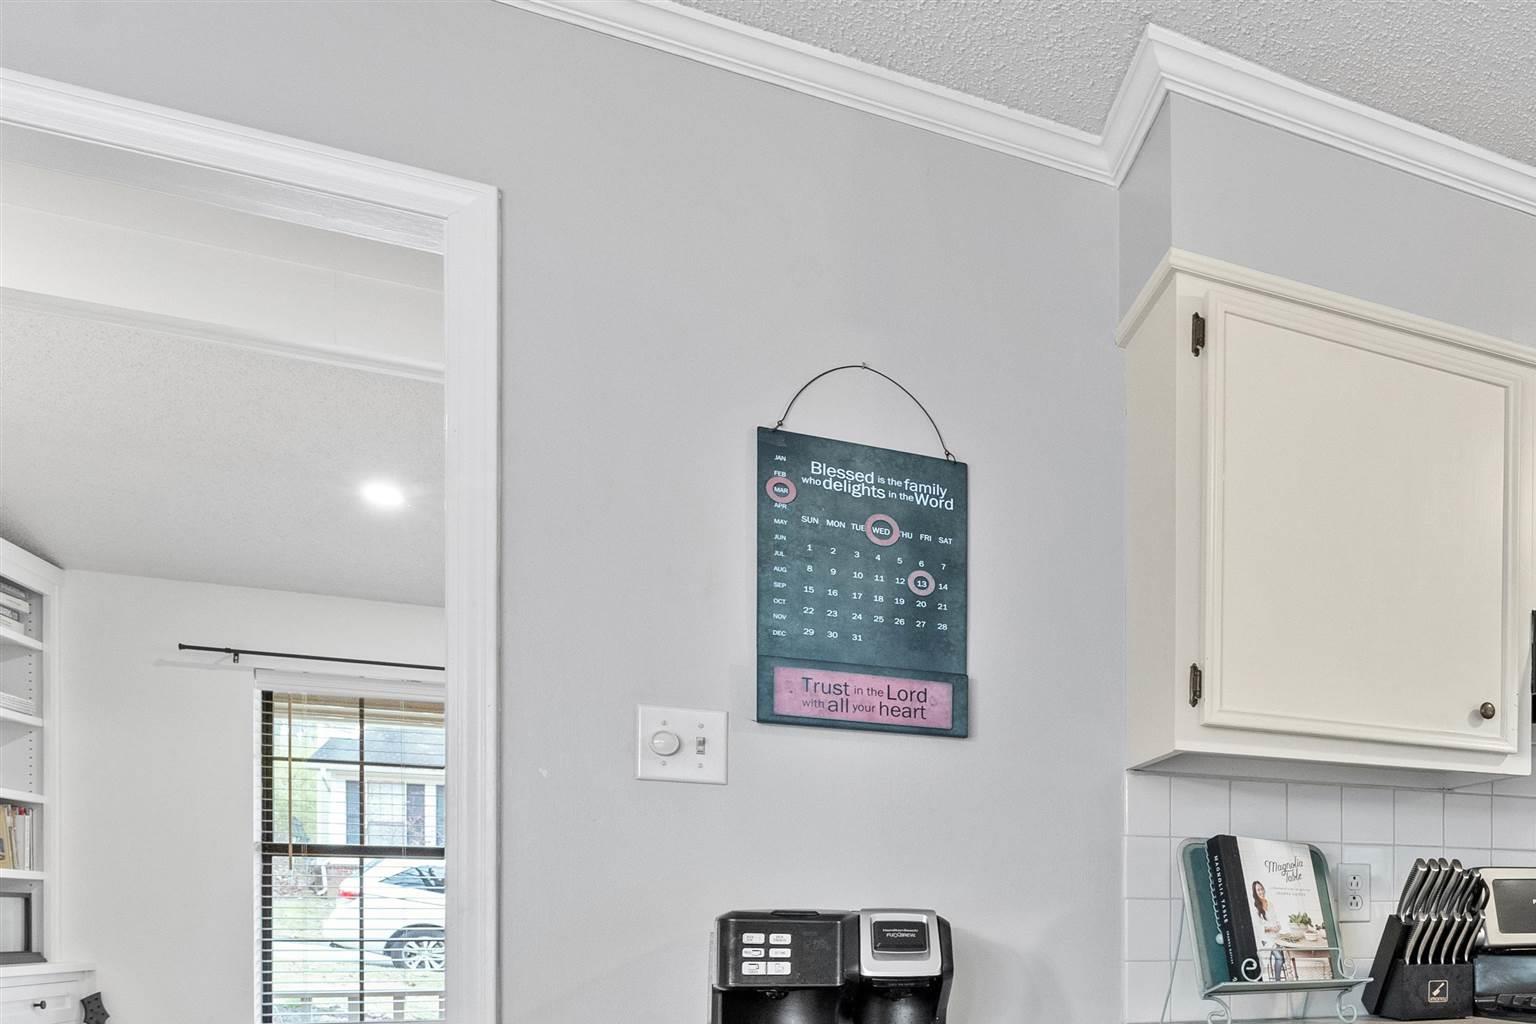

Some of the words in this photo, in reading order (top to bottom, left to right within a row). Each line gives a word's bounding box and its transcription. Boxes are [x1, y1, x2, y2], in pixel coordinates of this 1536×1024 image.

[811, 461, 874, 484] Blessed
[878, 476, 885, 484] is
[888, 478, 902, 487] the
[904, 479, 947, 498] family
[802, 476, 821, 486] who
[823, 477, 885, 498] delights
[899, 493, 914, 501] the
[914, 492, 954, 510] Word
[801, 515, 819, 524] SUN
[826, 519, 846, 528] MON
[851, 523, 865, 532] TUE
[872, 527, 890, 536] WED
[920, 533, 932, 542] FRI
[939, 536, 953, 545] SAT
[830, 547, 837, 555] 2
[917, 580, 927, 588] 13
[874, 595, 884, 603] 18
[803, 628, 815, 636] 29
[937, 623, 948, 631] 28
[801, 677, 850, 696] Trust
[854, 686, 863, 695] in
[867, 687, 884, 697] the
[887, 685, 927, 703] Lord
[802, 699, 825, 709] with
[828, 698, 848, 713] all
[852, 703, 875, 714] your
[879, 702, 927, 720] heart
[1264, 856, 1303, 876] Magnolia
[1214, 855, 1223, 896] MAGNOLIA
[1221, 899, 1229, 923] TABLE
